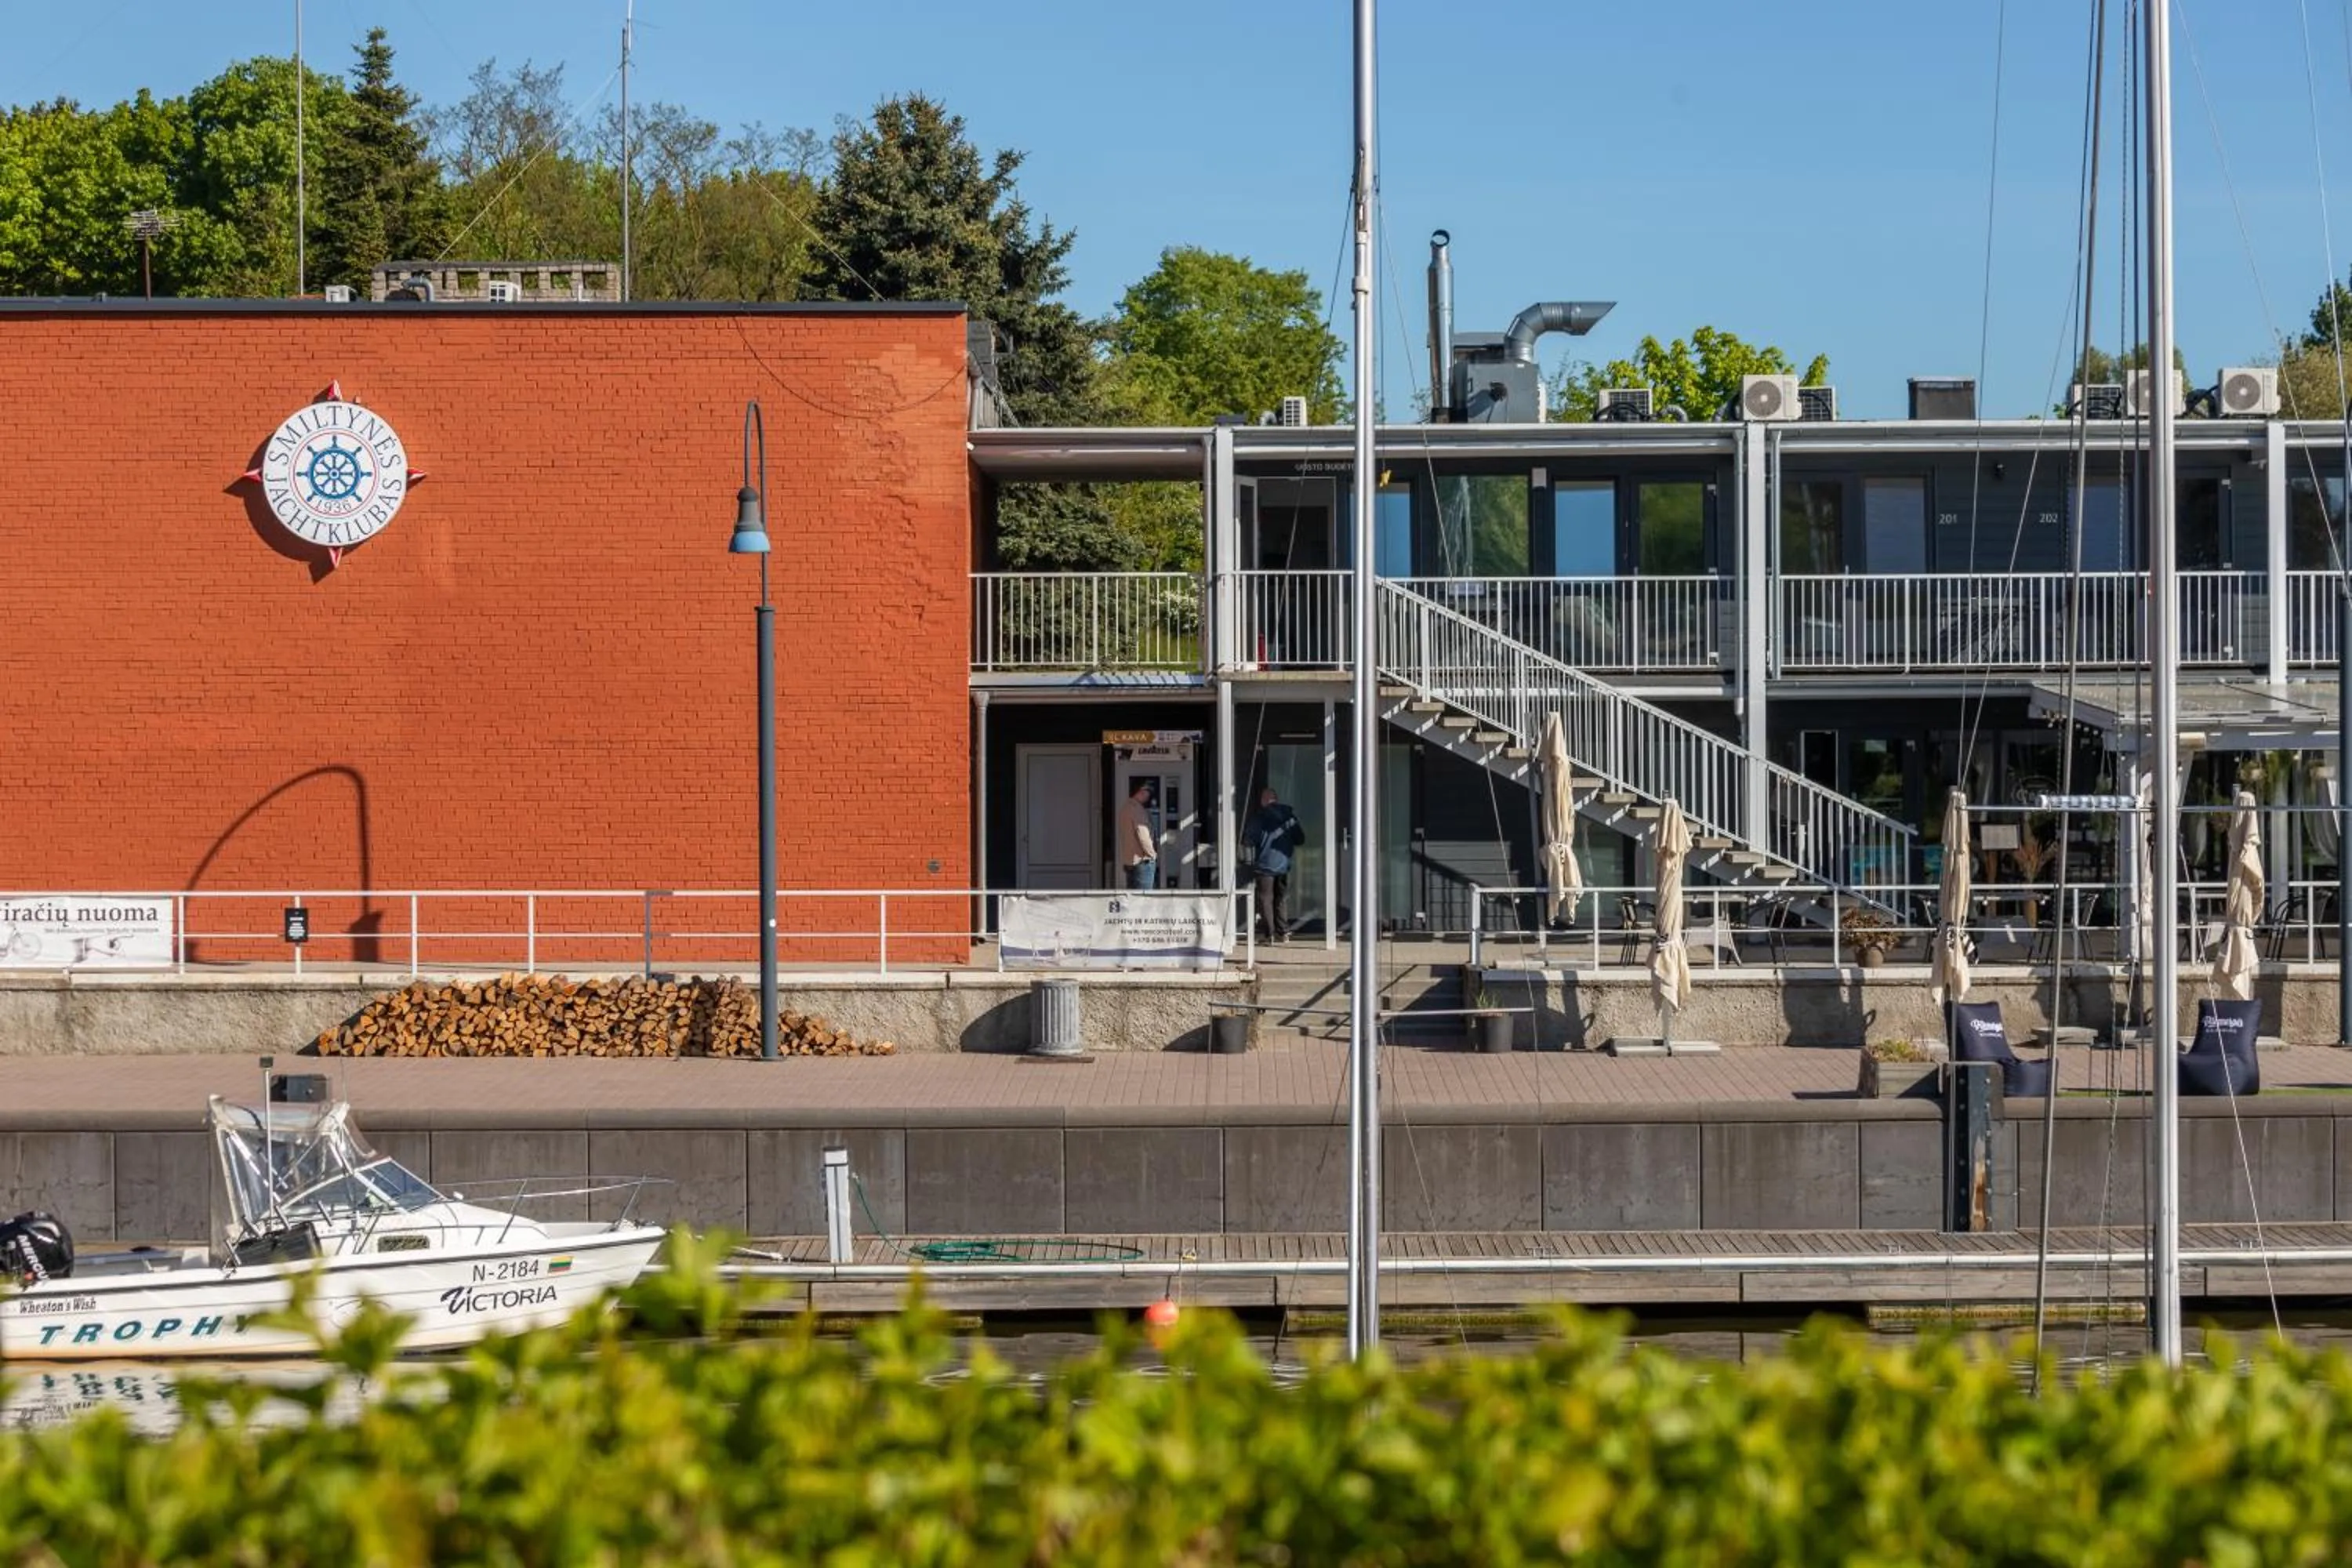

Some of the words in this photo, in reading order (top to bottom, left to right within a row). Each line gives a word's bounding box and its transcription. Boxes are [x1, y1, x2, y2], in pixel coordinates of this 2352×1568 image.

[267, 405, 401, 469] SMILTYNĖS
[265, 474, 402, 543] JACHTKLUBAS
[314, 499, 352, 514] 1936
[1939, 514, 1958, 524] 201
[2039, 513, 2058, 524] 202
[0, 902, 69, 927] iračių
[77, 906, 158, 922] nuoma
[17, 1235, 50, 1280] MERCU
[473, 1259, 539, 1282] N-2184
[73, 1296, 96, 1310] Wish
